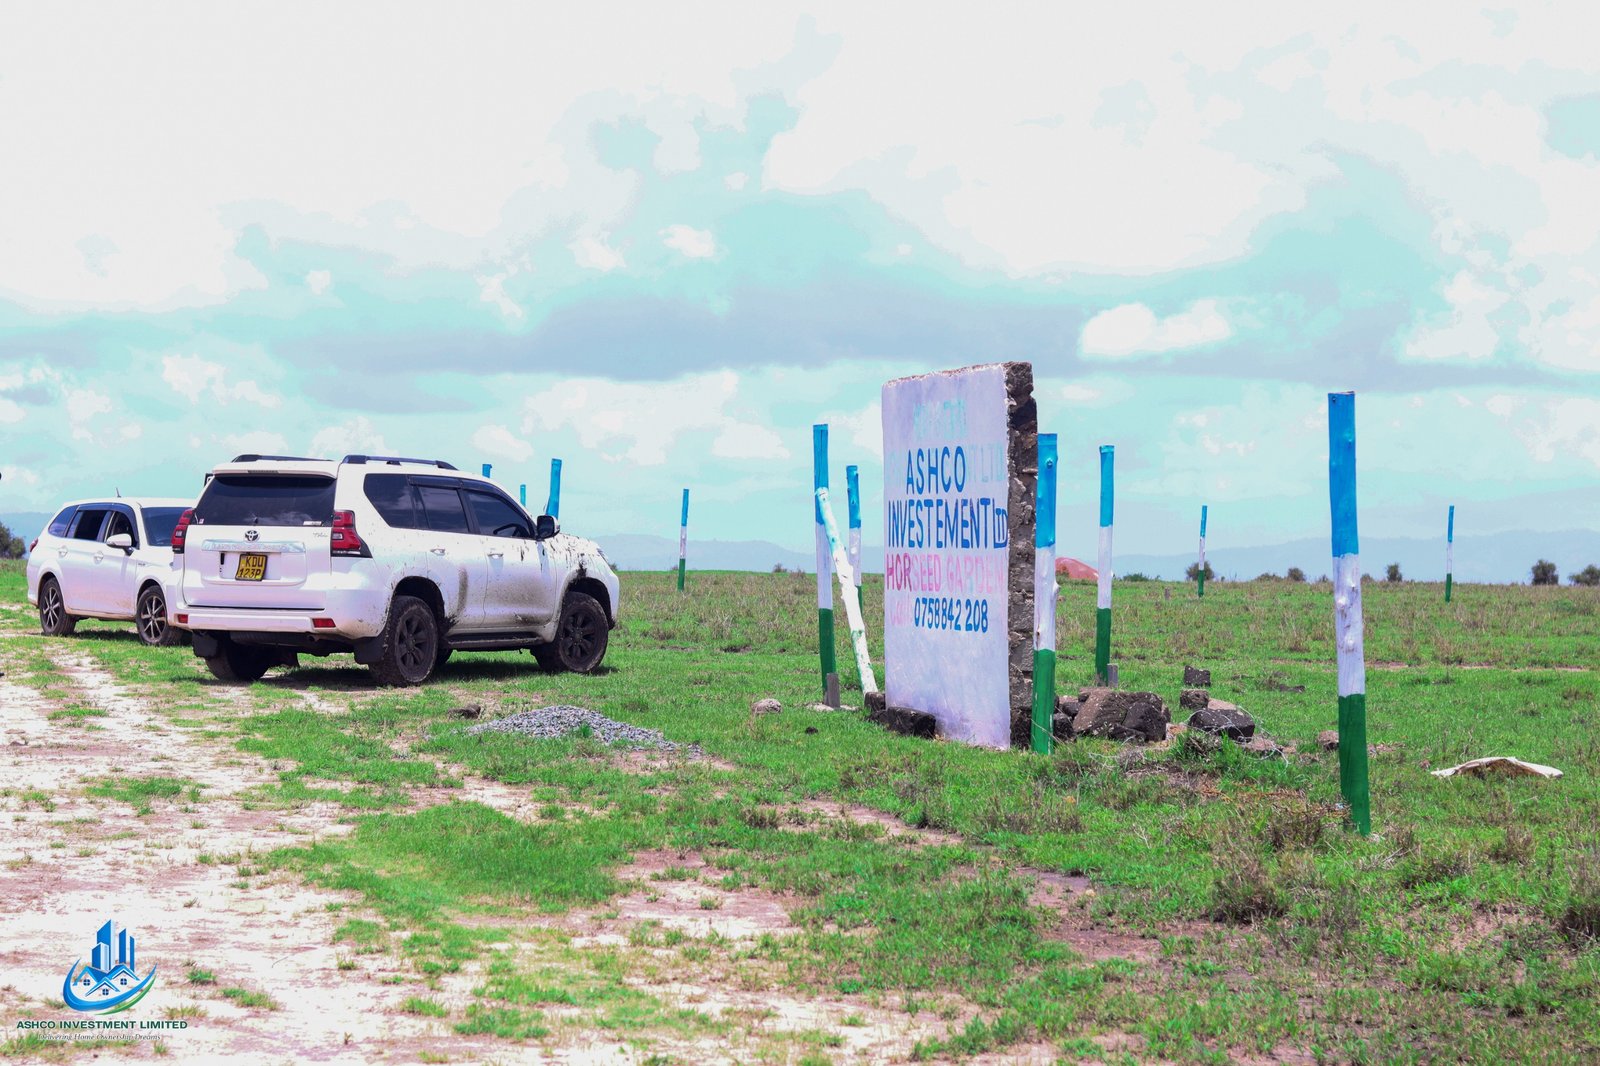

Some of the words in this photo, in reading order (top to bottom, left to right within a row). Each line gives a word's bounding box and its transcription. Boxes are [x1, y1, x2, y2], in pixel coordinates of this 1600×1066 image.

[906, 446, 966, 495] ASHCO
[888, 498, 991, 549] INVESTEMENT
[238, 568, 261, 578] 123P
[245, 556, 264, 567] KDU
[886, 553, 942, 592] HORSEED
